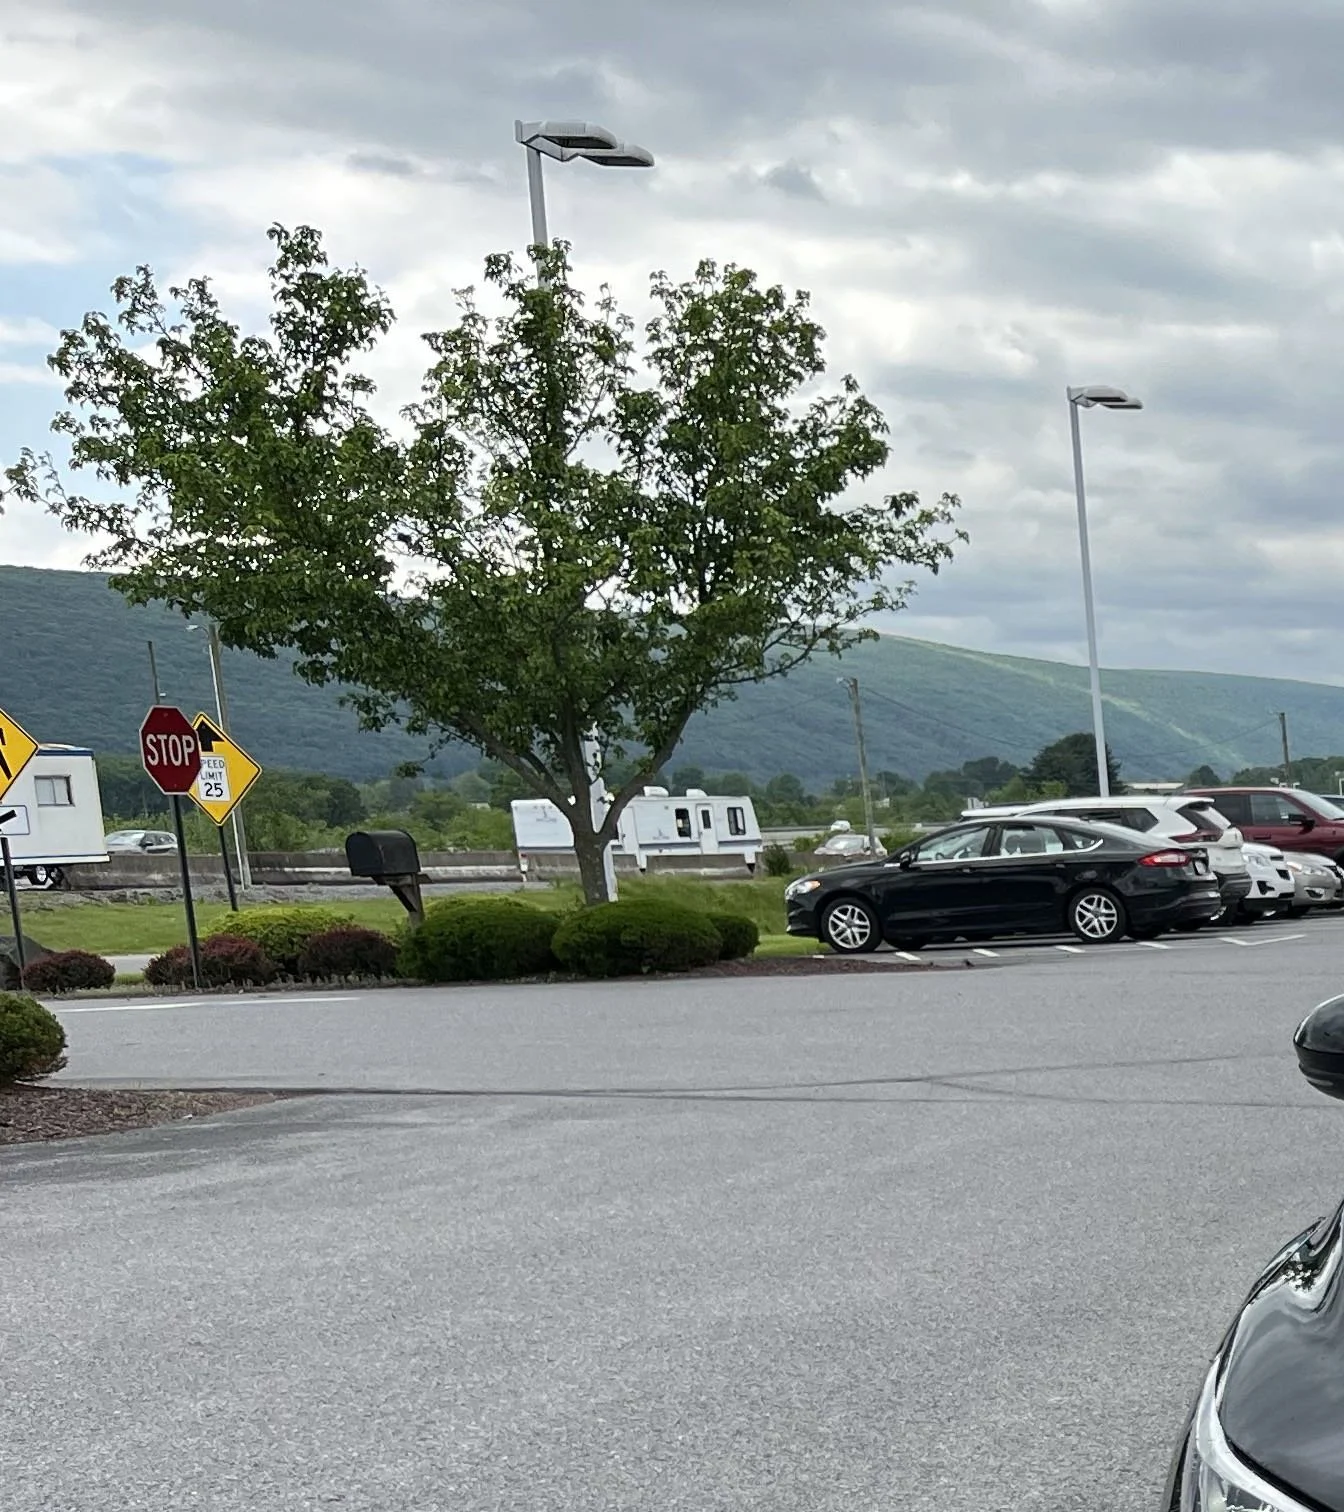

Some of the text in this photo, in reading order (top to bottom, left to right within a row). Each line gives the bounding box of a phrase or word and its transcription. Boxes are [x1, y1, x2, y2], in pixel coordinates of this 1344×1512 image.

[146, 734, 195, 766] STOP
[201, 759, 225, 769] PEED
[204, 782, 224, 798] 25
